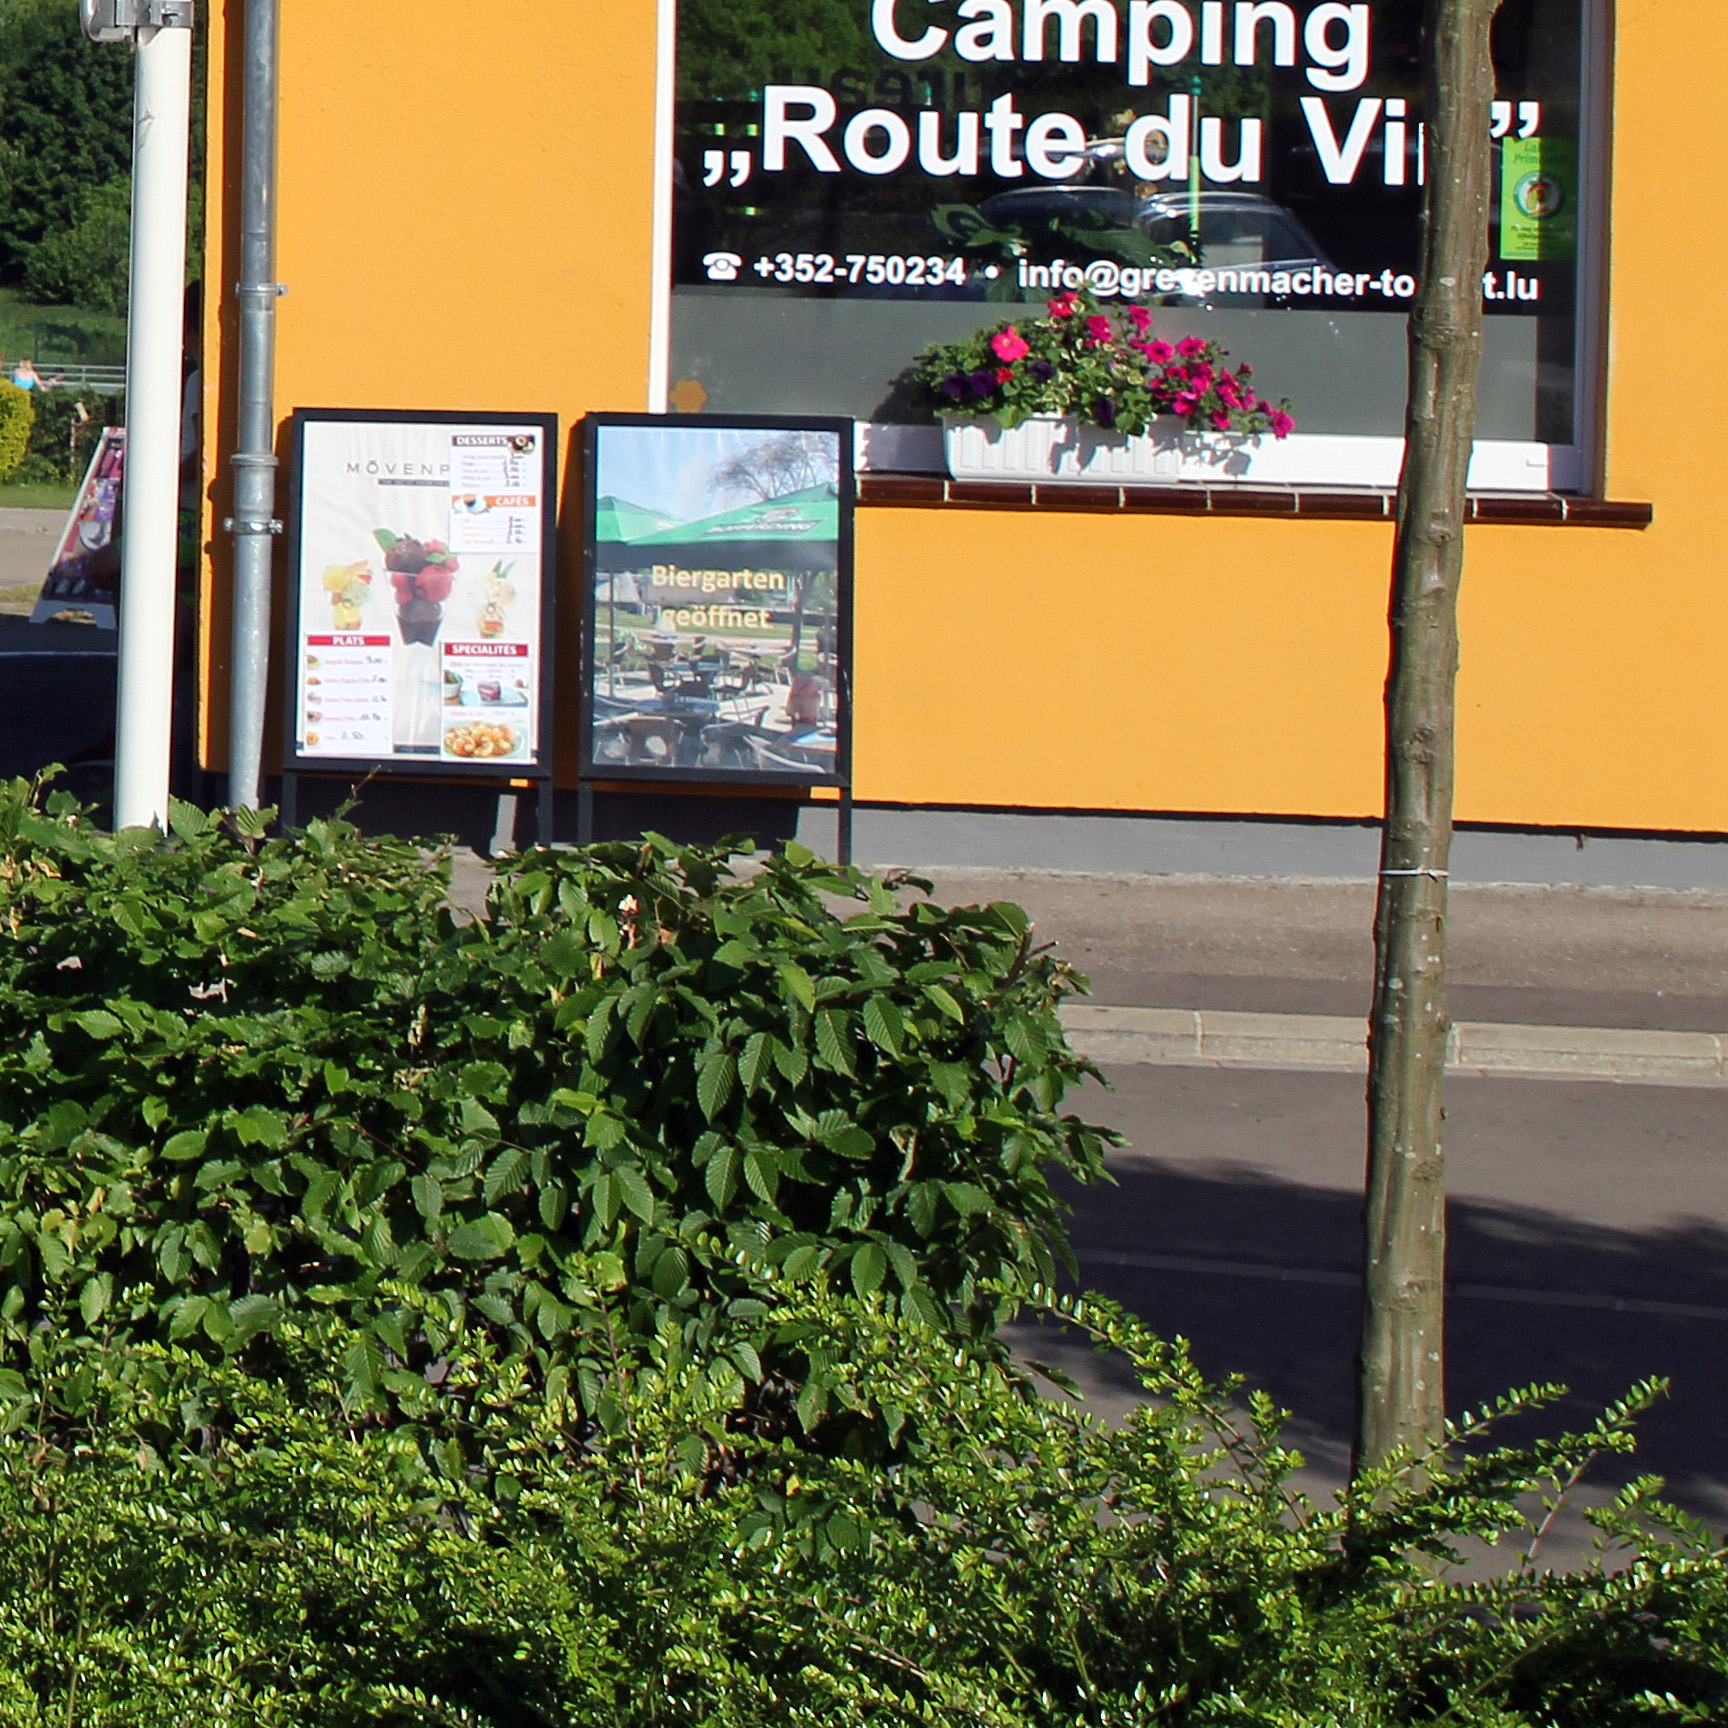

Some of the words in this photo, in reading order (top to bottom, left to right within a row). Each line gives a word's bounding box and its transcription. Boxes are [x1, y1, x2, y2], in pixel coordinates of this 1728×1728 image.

[1123, 93, 1262, 183] du
[1300, 96, 1540, 186] Vi”
[753, 253, 967, 286] +352-750234
[455, 436, 509, 447] DESSERTS
[345, 459, 450, 477] MÖVENP
[651, 564, 787, 593] Biergarten
[332, 636, 366, 646] PLATS
